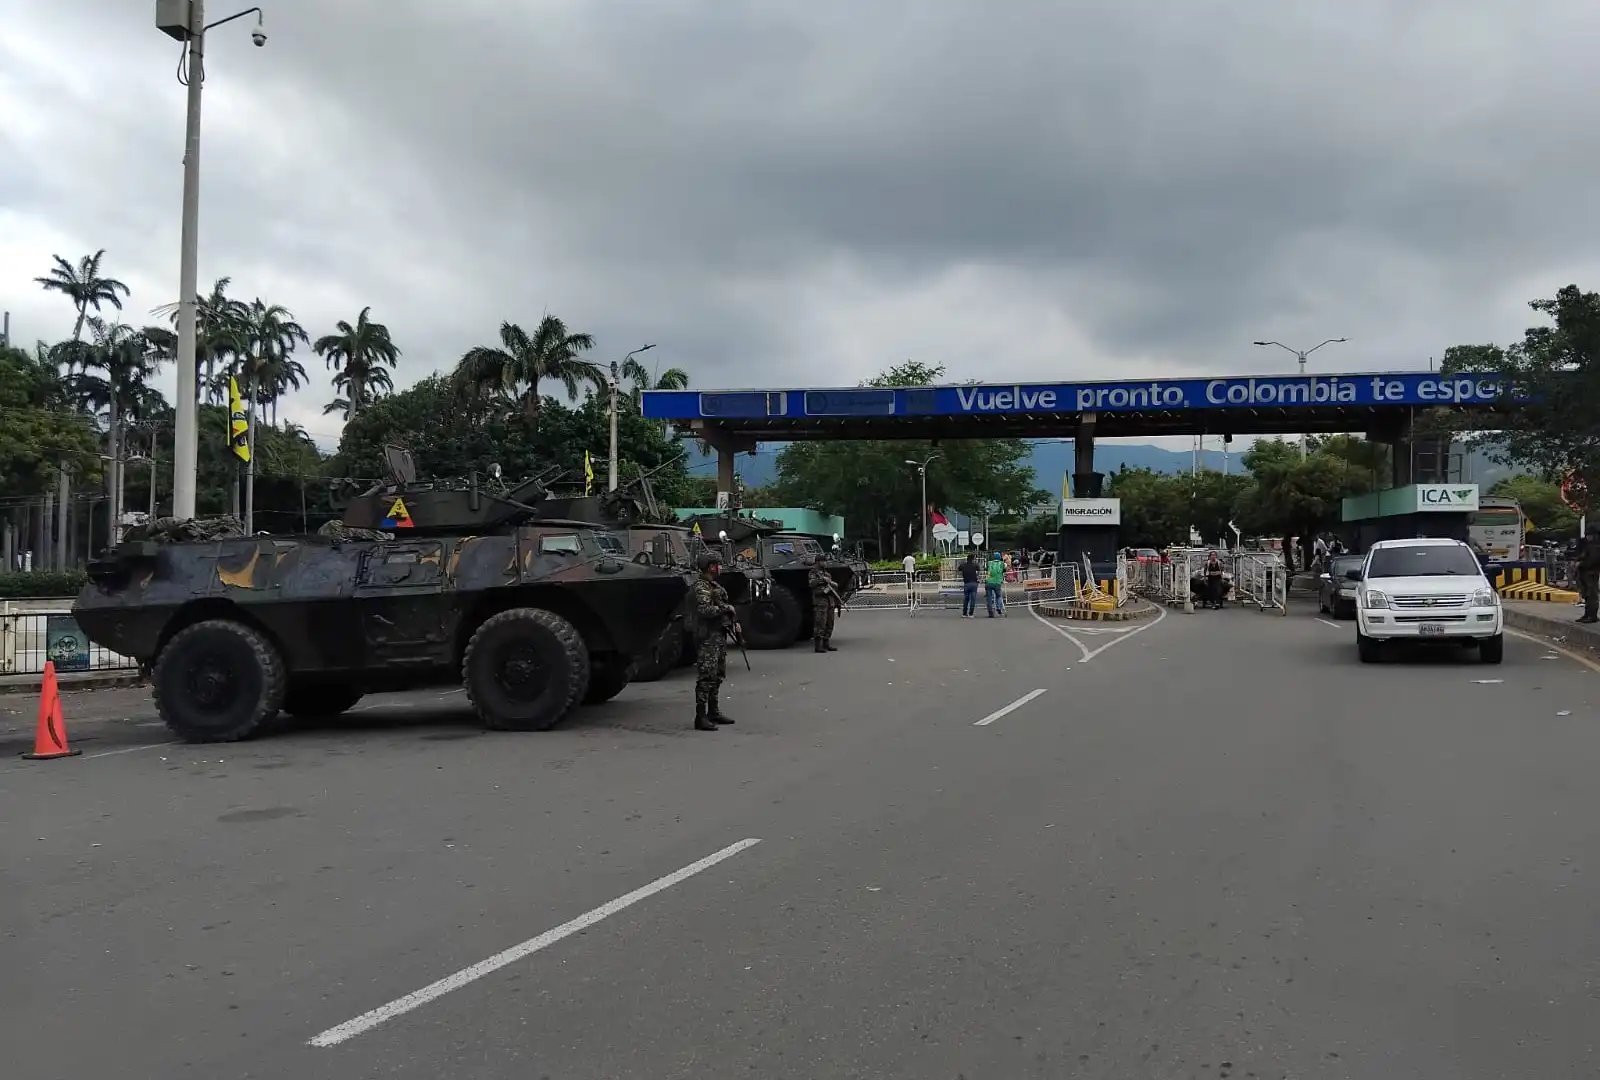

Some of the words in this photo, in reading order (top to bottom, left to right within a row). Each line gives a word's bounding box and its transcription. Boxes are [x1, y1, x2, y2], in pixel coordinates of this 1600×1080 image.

[956, 386, 1057, 411] Vuelve
[1206, 377, 1356, 404] Colombia
[1370, 377, 1405, 401] te
[1422, 489, 1451, 503] ICA
[1065, 507, 1112, 515] MIGRACIÓN
